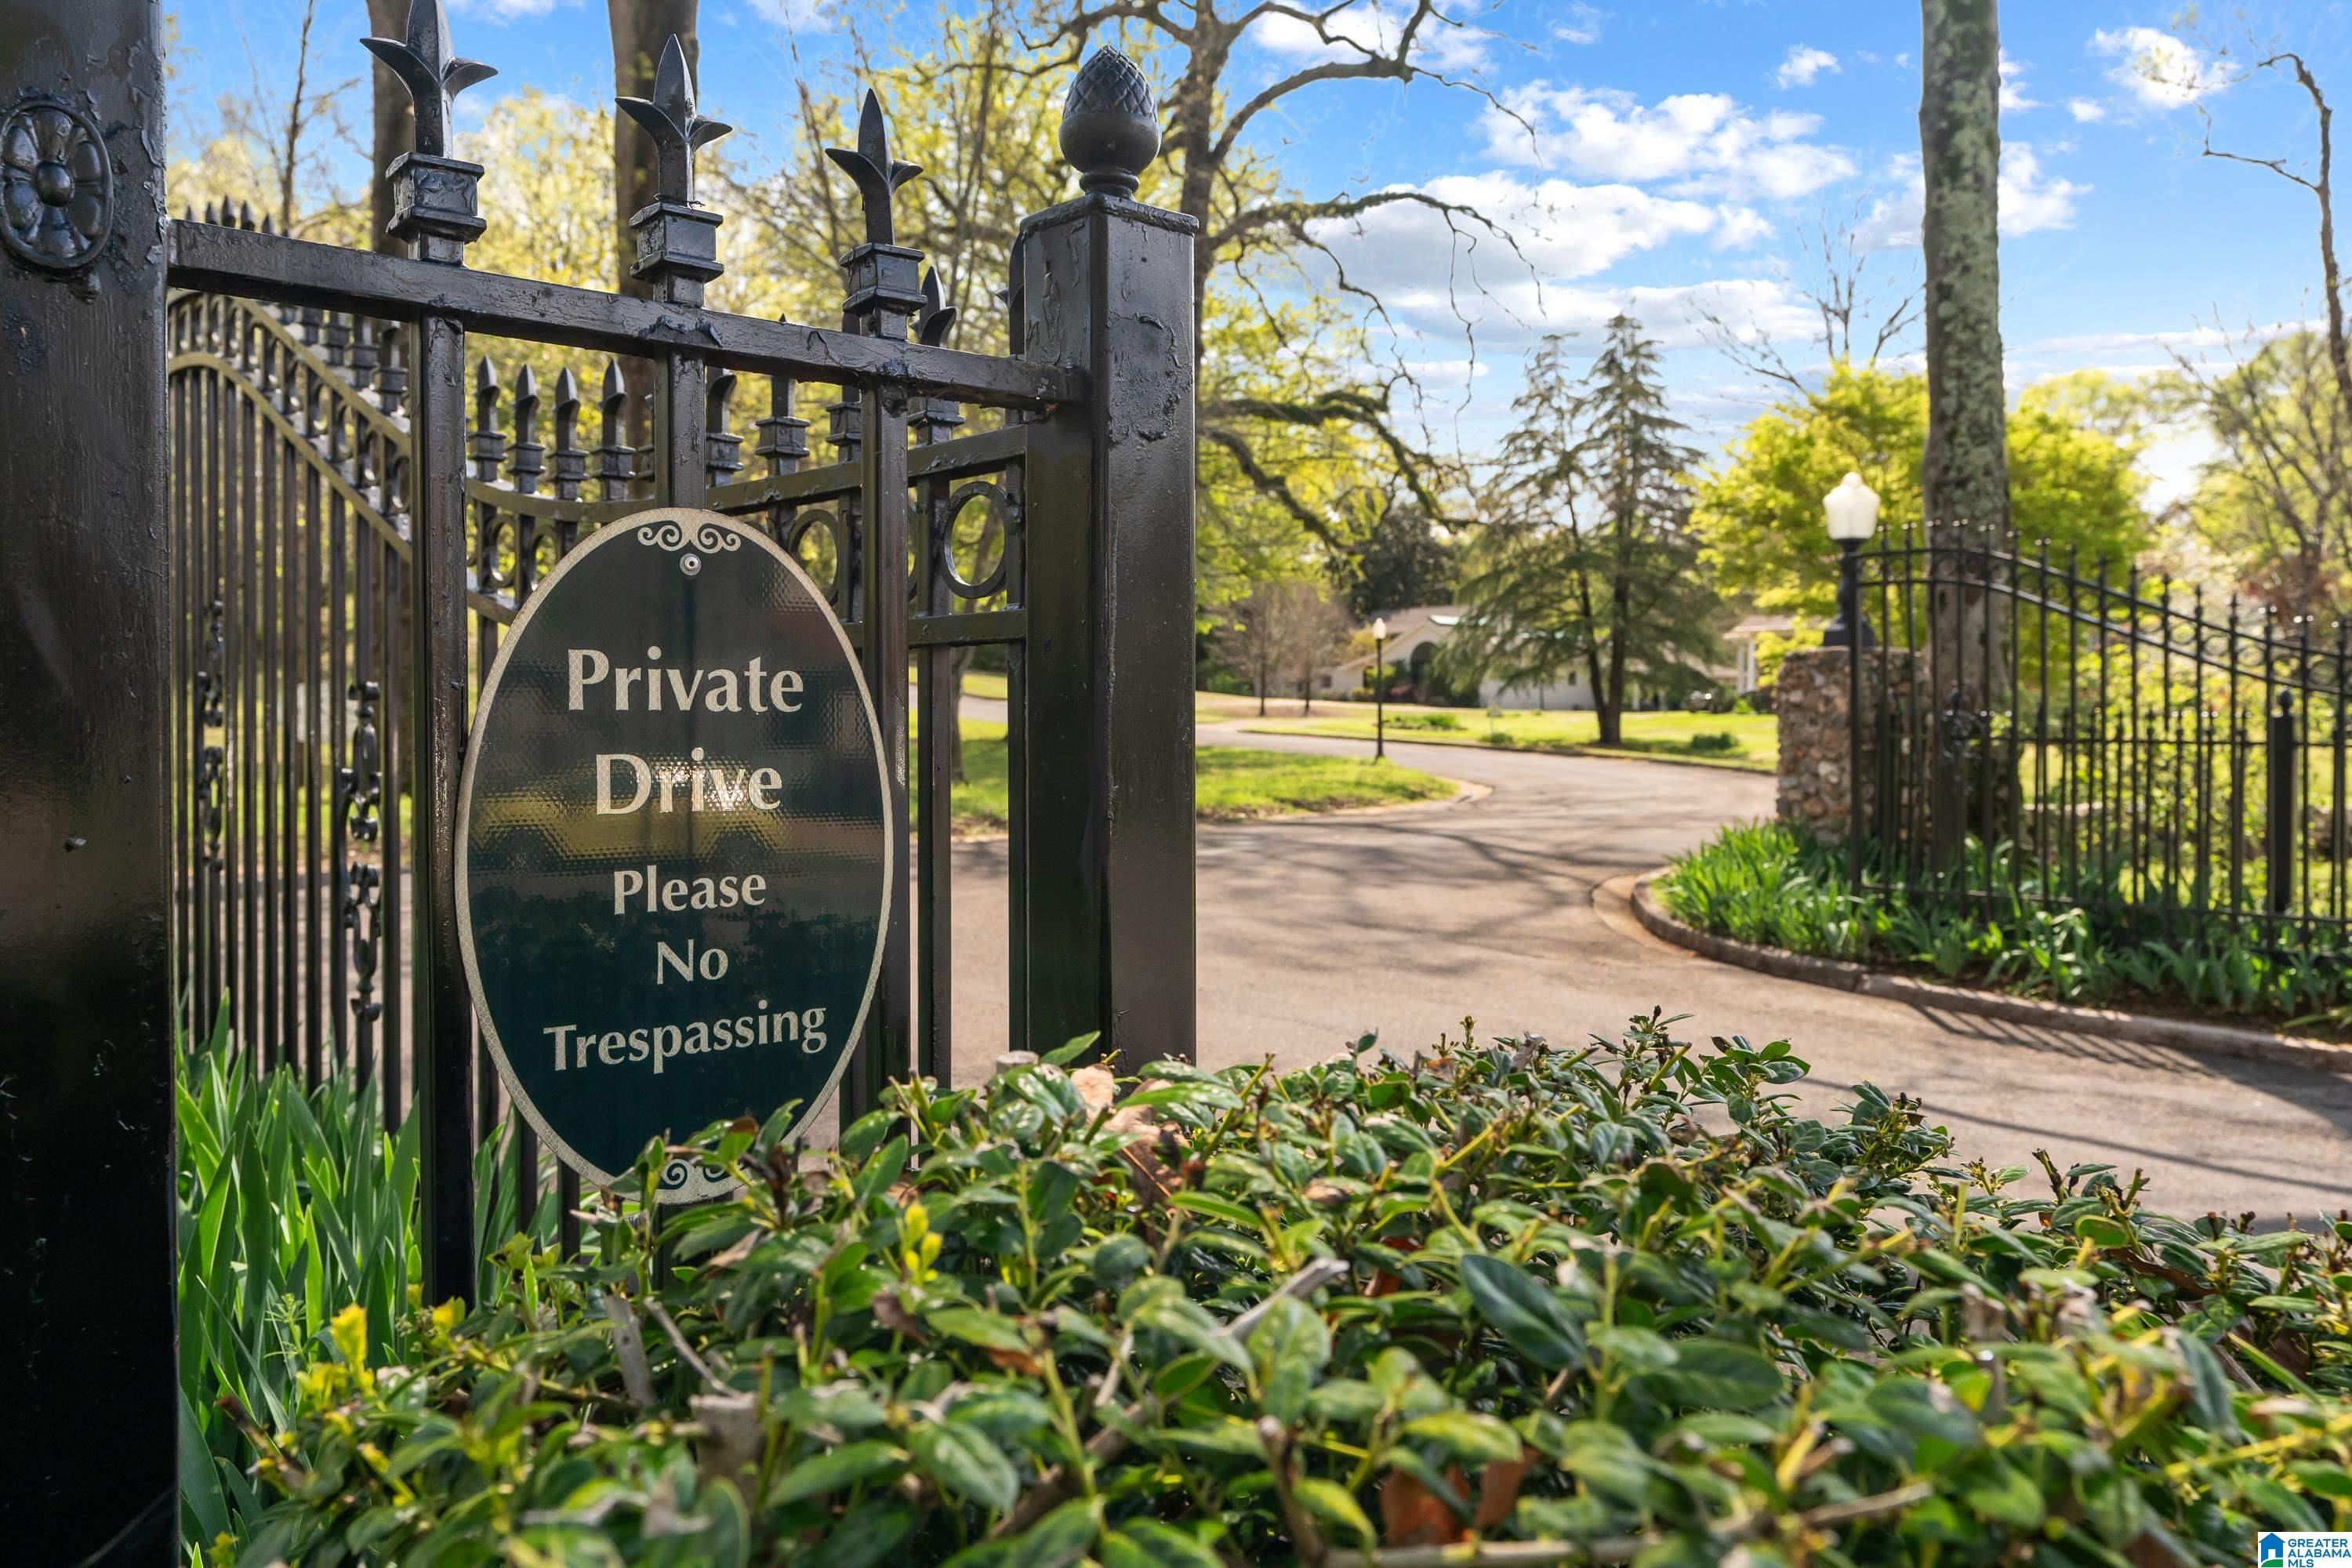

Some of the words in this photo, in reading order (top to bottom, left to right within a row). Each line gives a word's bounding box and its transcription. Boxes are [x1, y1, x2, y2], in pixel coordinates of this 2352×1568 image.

[568, 645, 805, 713] Private
[594, 747, 783, 816] Drive
[614, 864, 767, 916] Please
[656, 939, 729, 985] No
[543, 999, 828, 1075] Trespassing
